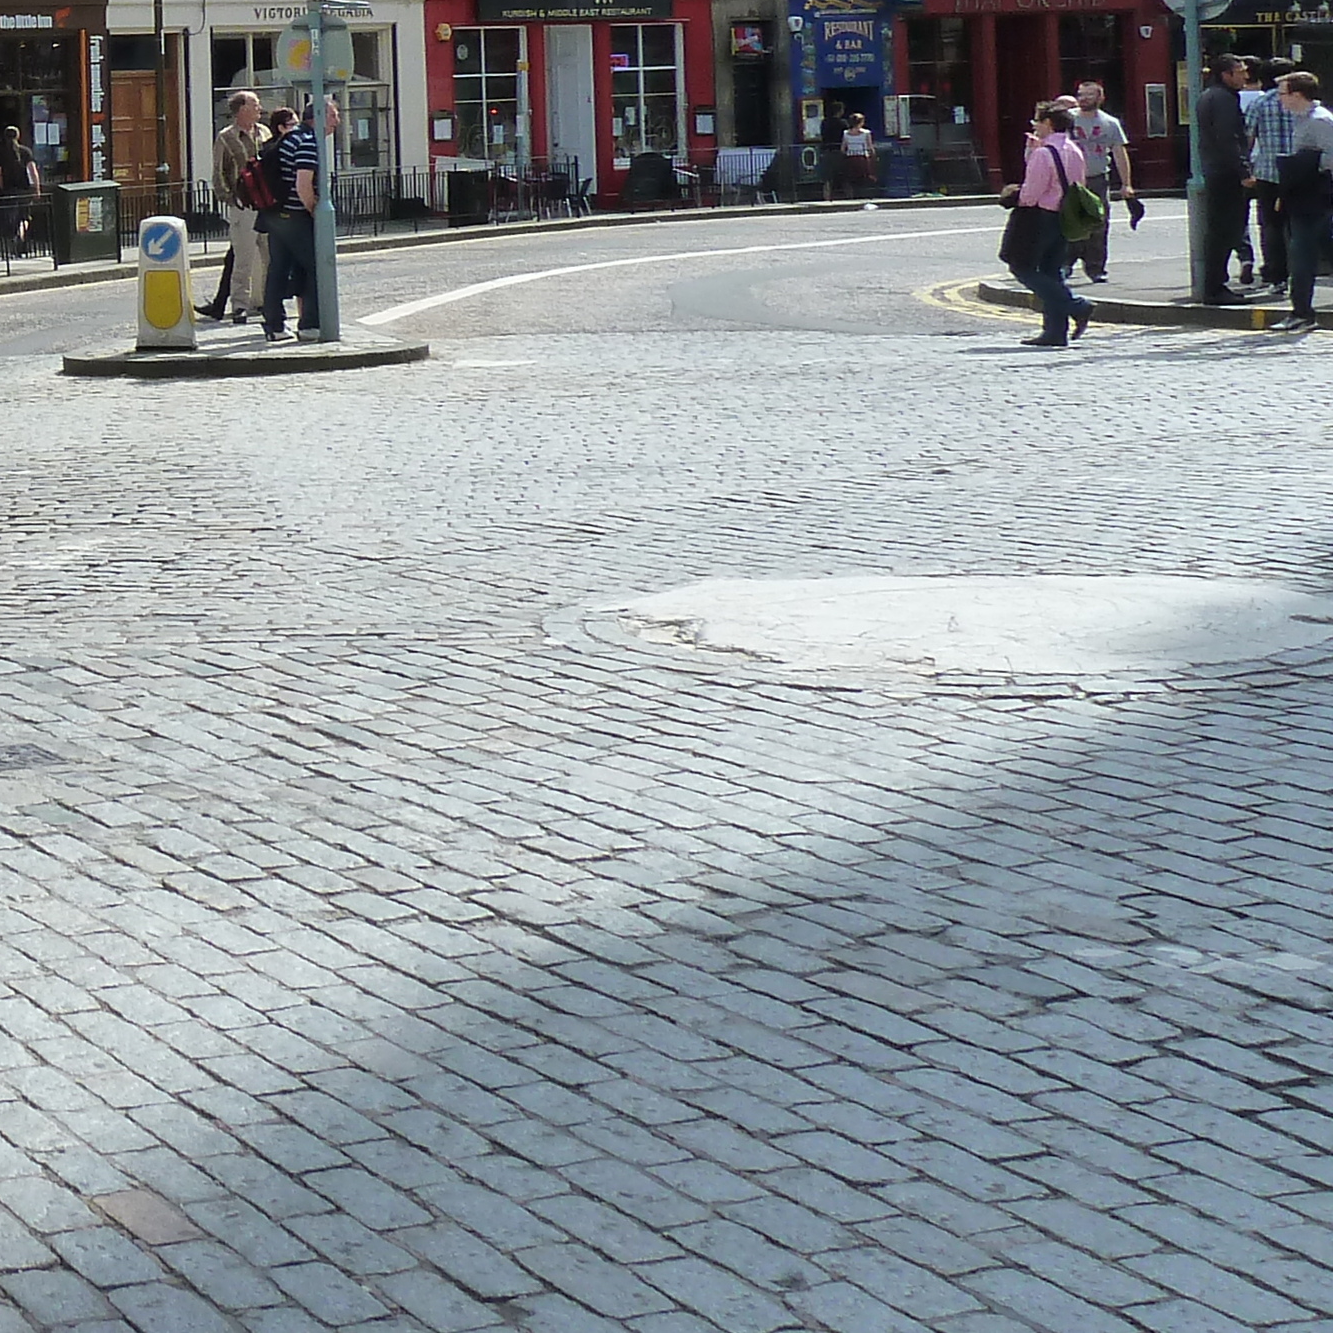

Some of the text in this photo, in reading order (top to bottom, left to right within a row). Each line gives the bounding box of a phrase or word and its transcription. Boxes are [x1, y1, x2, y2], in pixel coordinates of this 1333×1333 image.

[254, 7, 309, 20] VICTORI
[579, 7, 600, 16] EAST
[601, 6, 653, 16] RESTAURANT
[1255, 11, 1281, 23] THE
[0, 15, 15, 29] the
